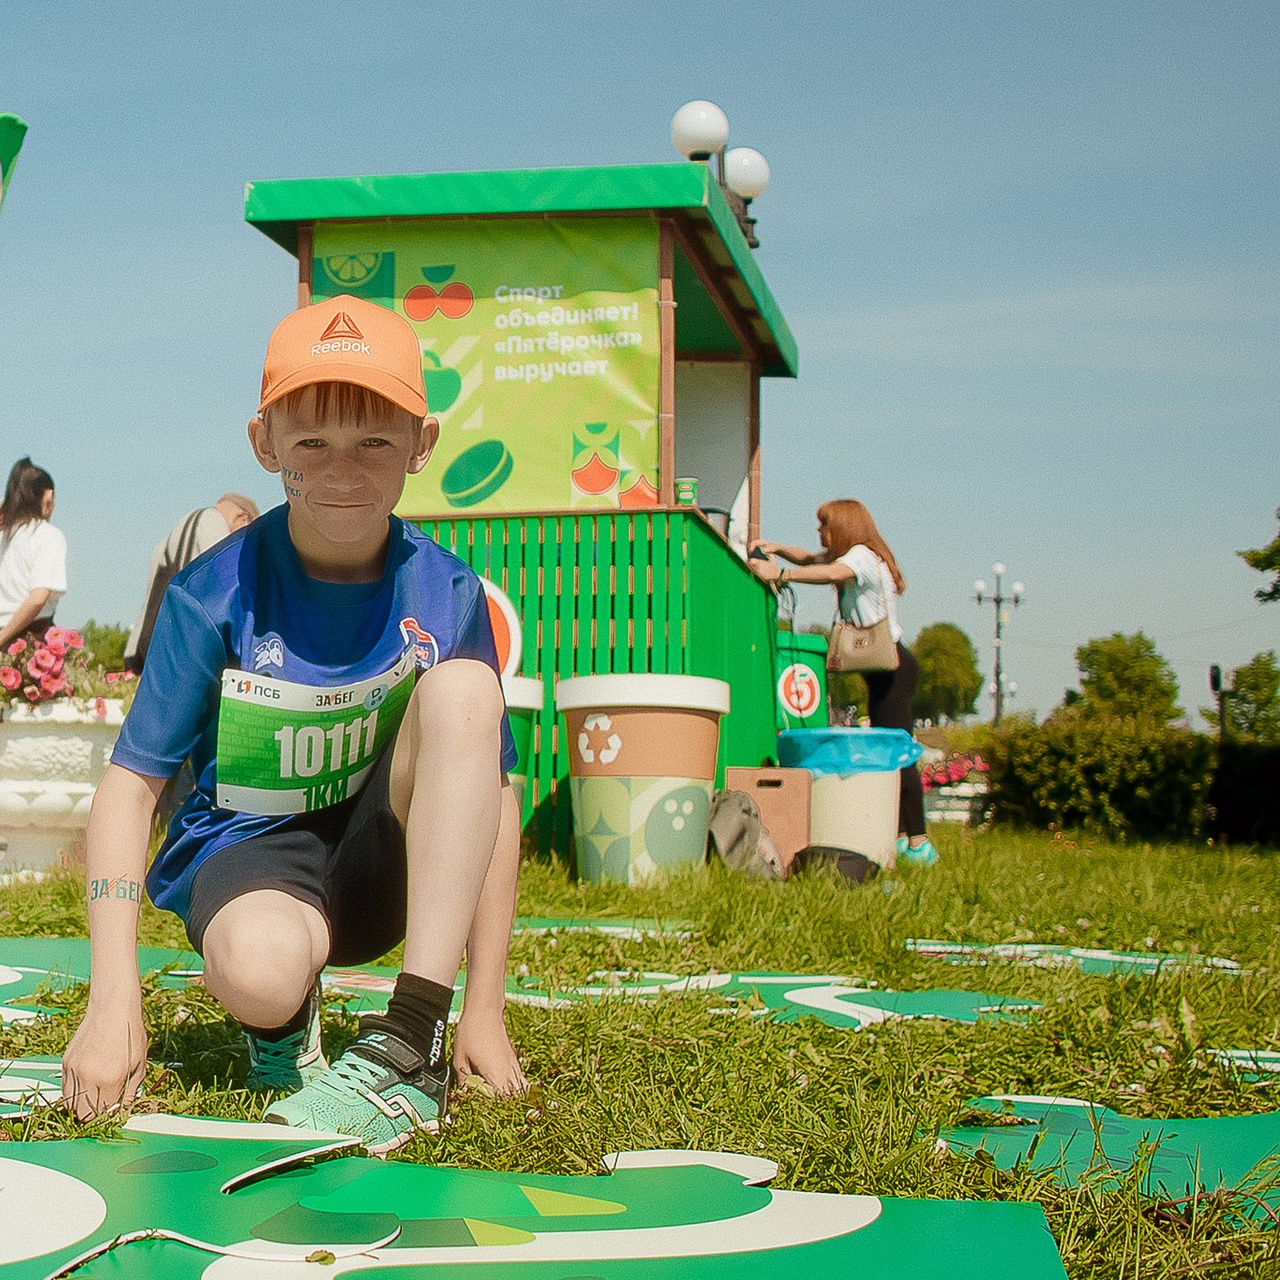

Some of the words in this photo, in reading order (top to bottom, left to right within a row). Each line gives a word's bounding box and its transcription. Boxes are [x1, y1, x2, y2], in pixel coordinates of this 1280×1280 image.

[494, 285, 564, 305] Спорт
[494, 303, 639, 329] объединяет!
[311, 339, 371, 357] Reebok
[494, 331, 643, 355] «Пятёрочка»
[494, 360, 610, 383] выручает
[254, 685, 280, 699] ПСБ
[274, 709, 379, 778] 10111
